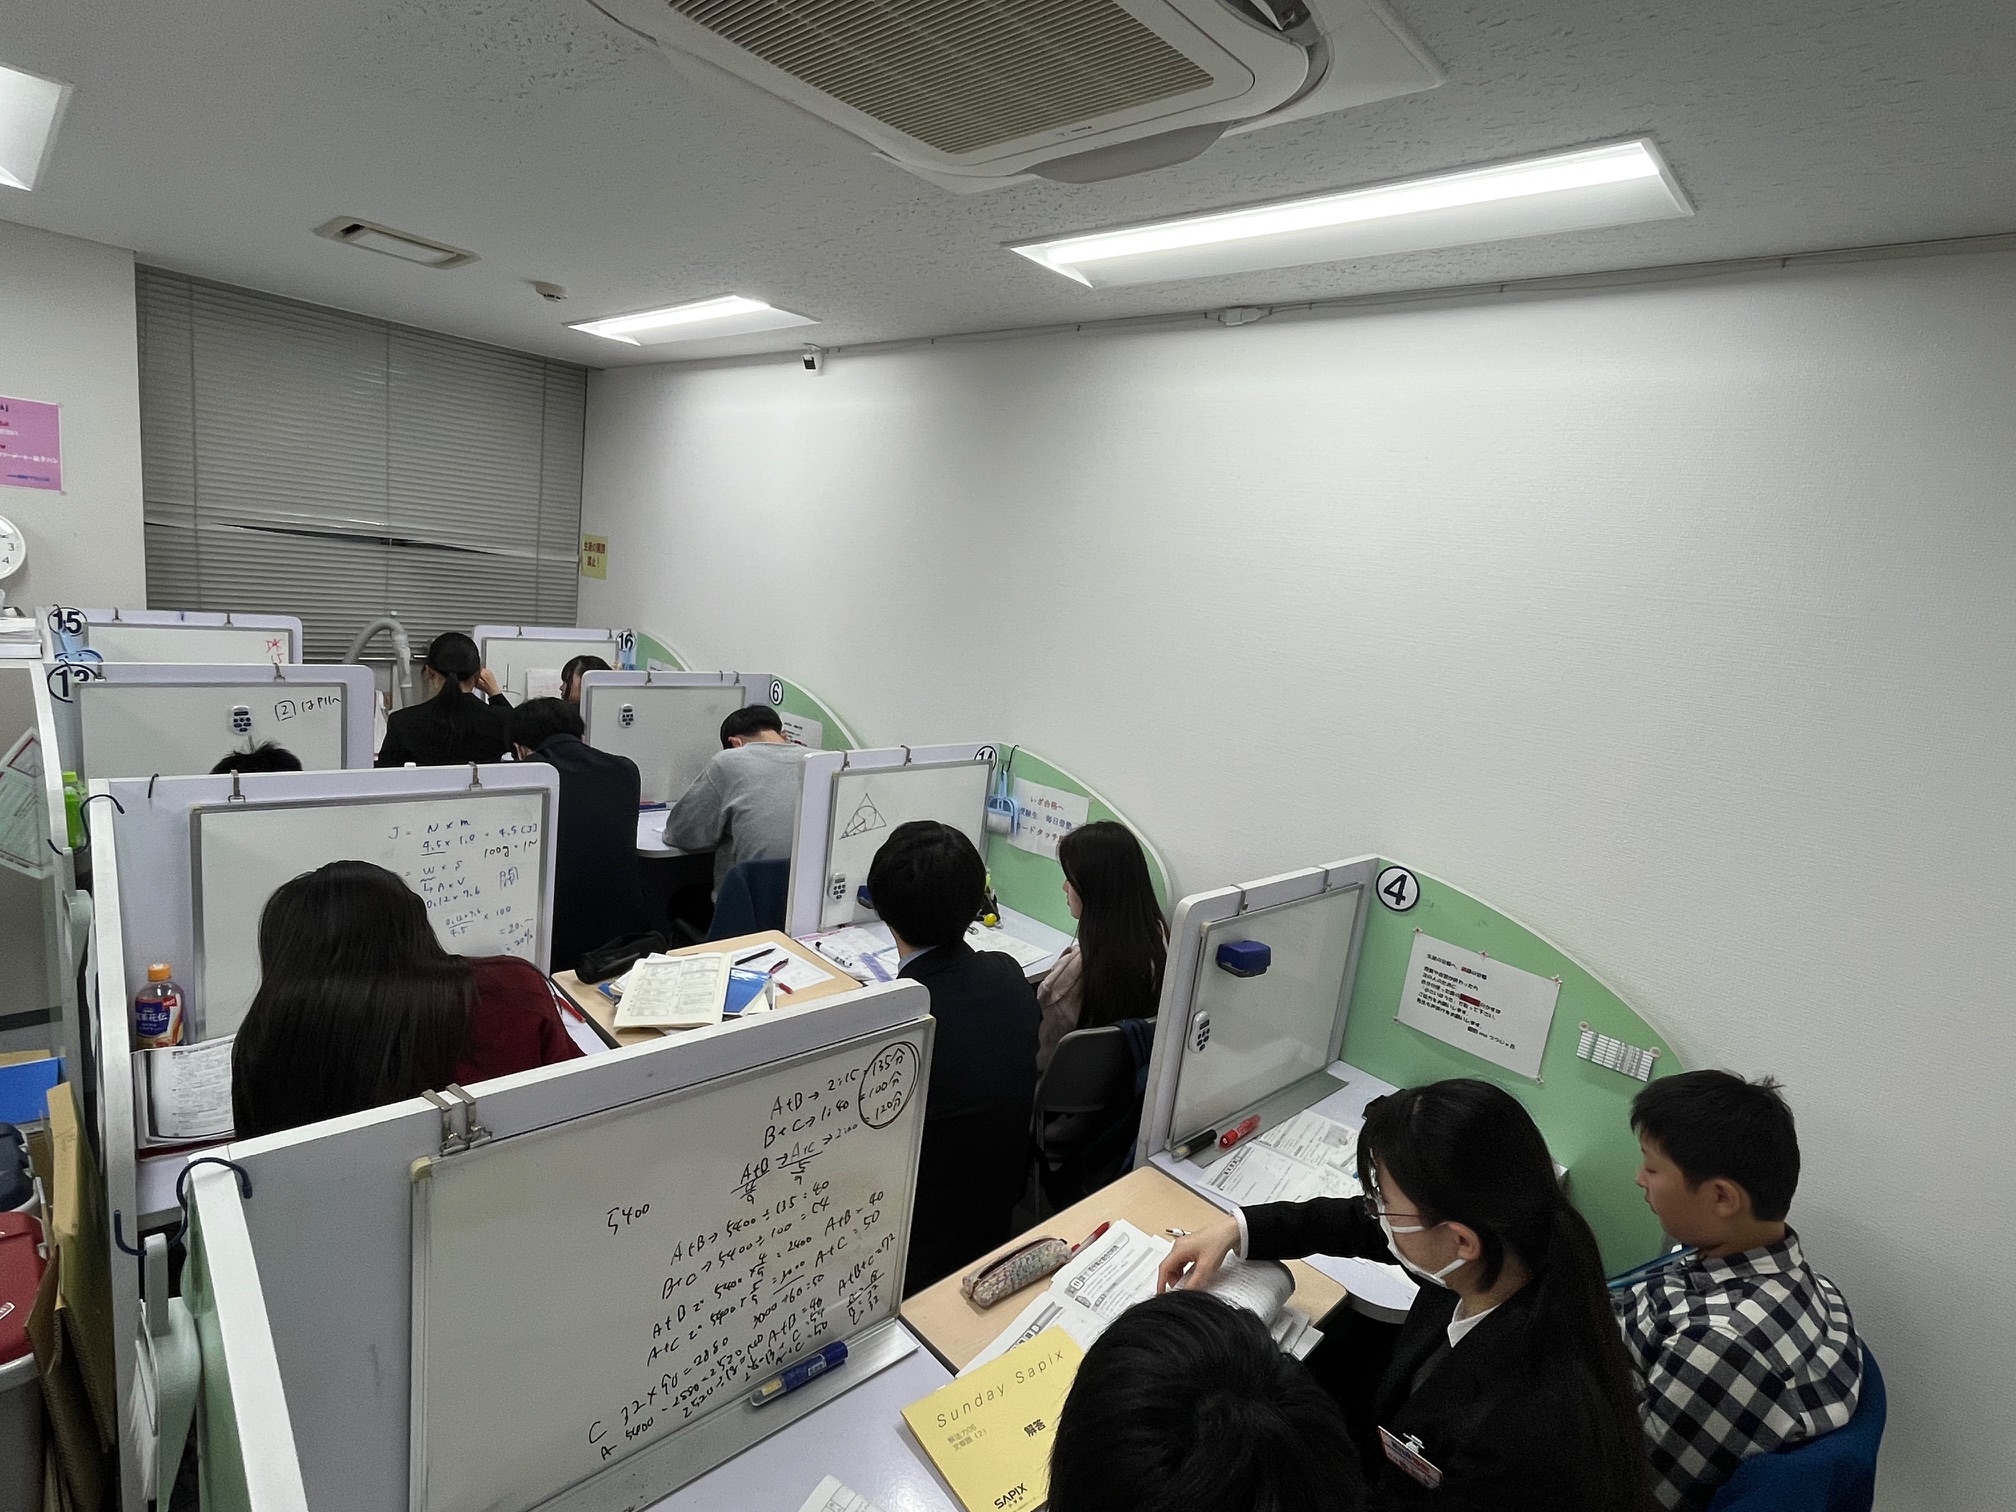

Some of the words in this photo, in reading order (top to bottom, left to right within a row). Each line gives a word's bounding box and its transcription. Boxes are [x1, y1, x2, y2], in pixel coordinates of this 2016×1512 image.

[8, 543, 15, 551] 3
[53, 610, 82, 634] 15
[618, 633, 634, 651] 16
[1030, 796, 1065, 812] いざ合格へ
[1383, 873, 1408, 906] 4
[606, 1203, 650, 1236] 5400
[936, 1383, 1005, 1428] Sunday
[1015, 1350, 1064, 1384] Sapix
[1023, 1418, 1047, 1437] 解答
[994, 1482, 1028, 1510] SAPIX
